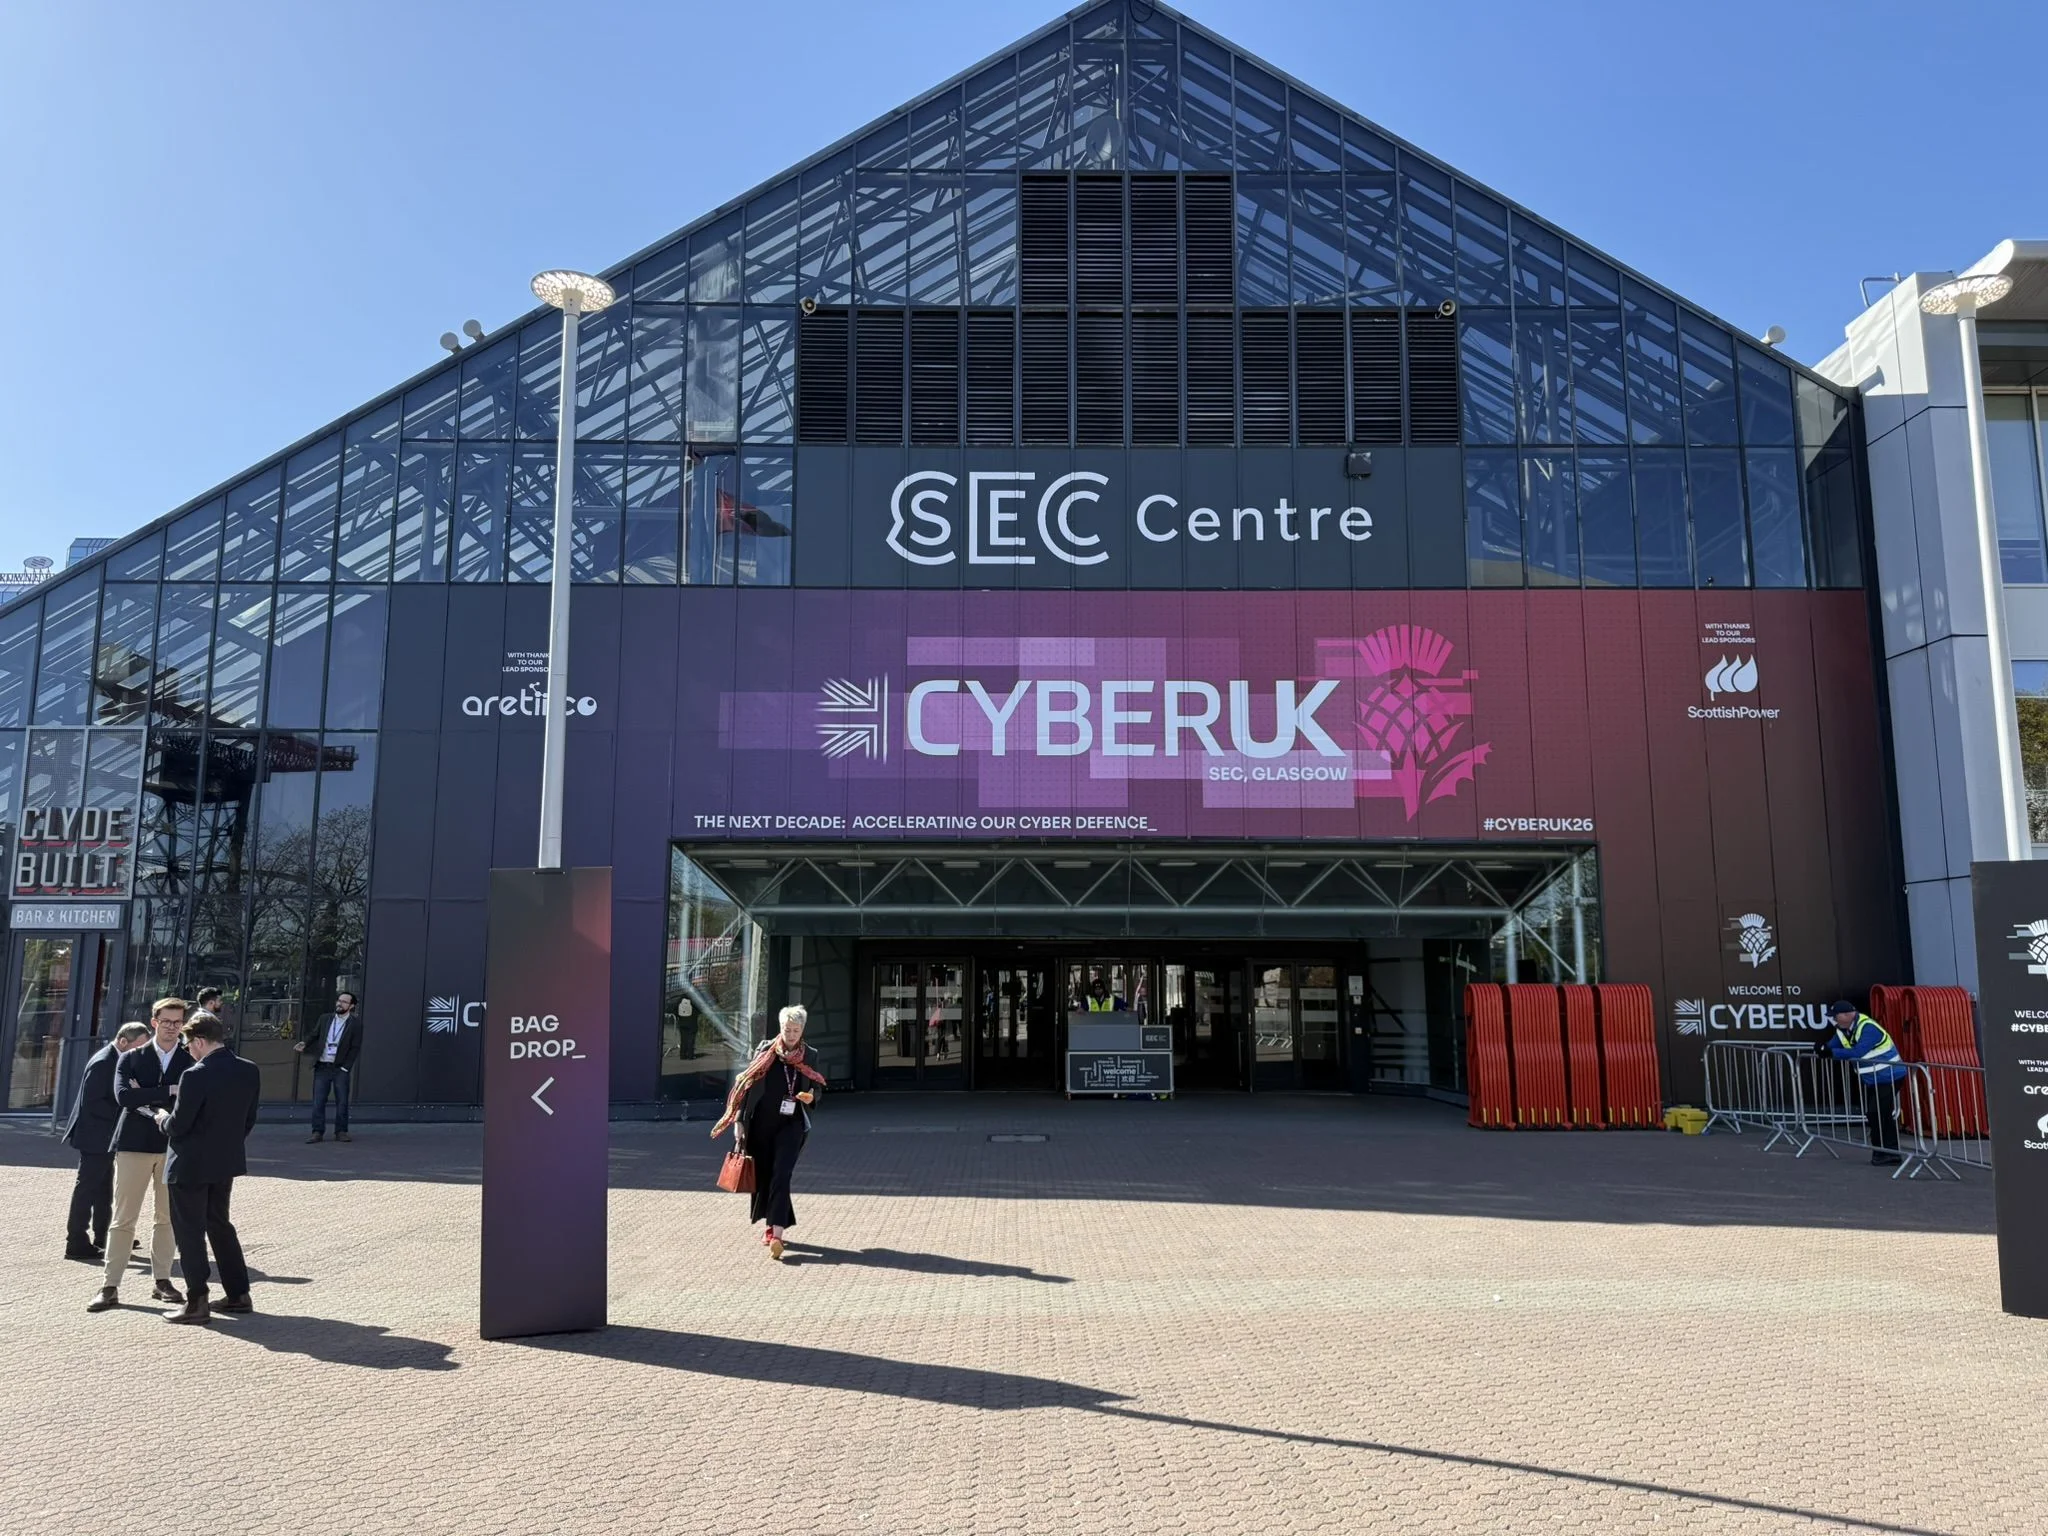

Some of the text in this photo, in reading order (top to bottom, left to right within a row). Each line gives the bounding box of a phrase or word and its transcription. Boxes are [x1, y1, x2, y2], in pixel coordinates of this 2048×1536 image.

[885, 470, 1373, 566] SEC Centre
[906, 679, 1347, 759] CYBERUK
[1687, 705, 1780, 719] ScottishPower
[1208, 766, 1348, 783] SEC, GLASGOW
[20, 807, 125, 841] CLYDE
[694, 815, 725, 828] THE
[729, 815, 771, 829] NEXT
[775, 815, 846, 829] DECADE:
[852, 815, 977, 829] ACCELERATING
[981, 816, 1016, 829] OUR
[1019, 816, 1071, 829] CYBER
[1483, 817, 1594, 832] #CYBERUK26
[16, 852, 117, 888] BUILT.
[16, 910, 116, 923] BAR & KITCHEN
[1728, 985, 1801, 996] WELCOME TO
[510, 1014, 560, 1034] BAG
[2024, 1139, 2048, 1150] Scot
